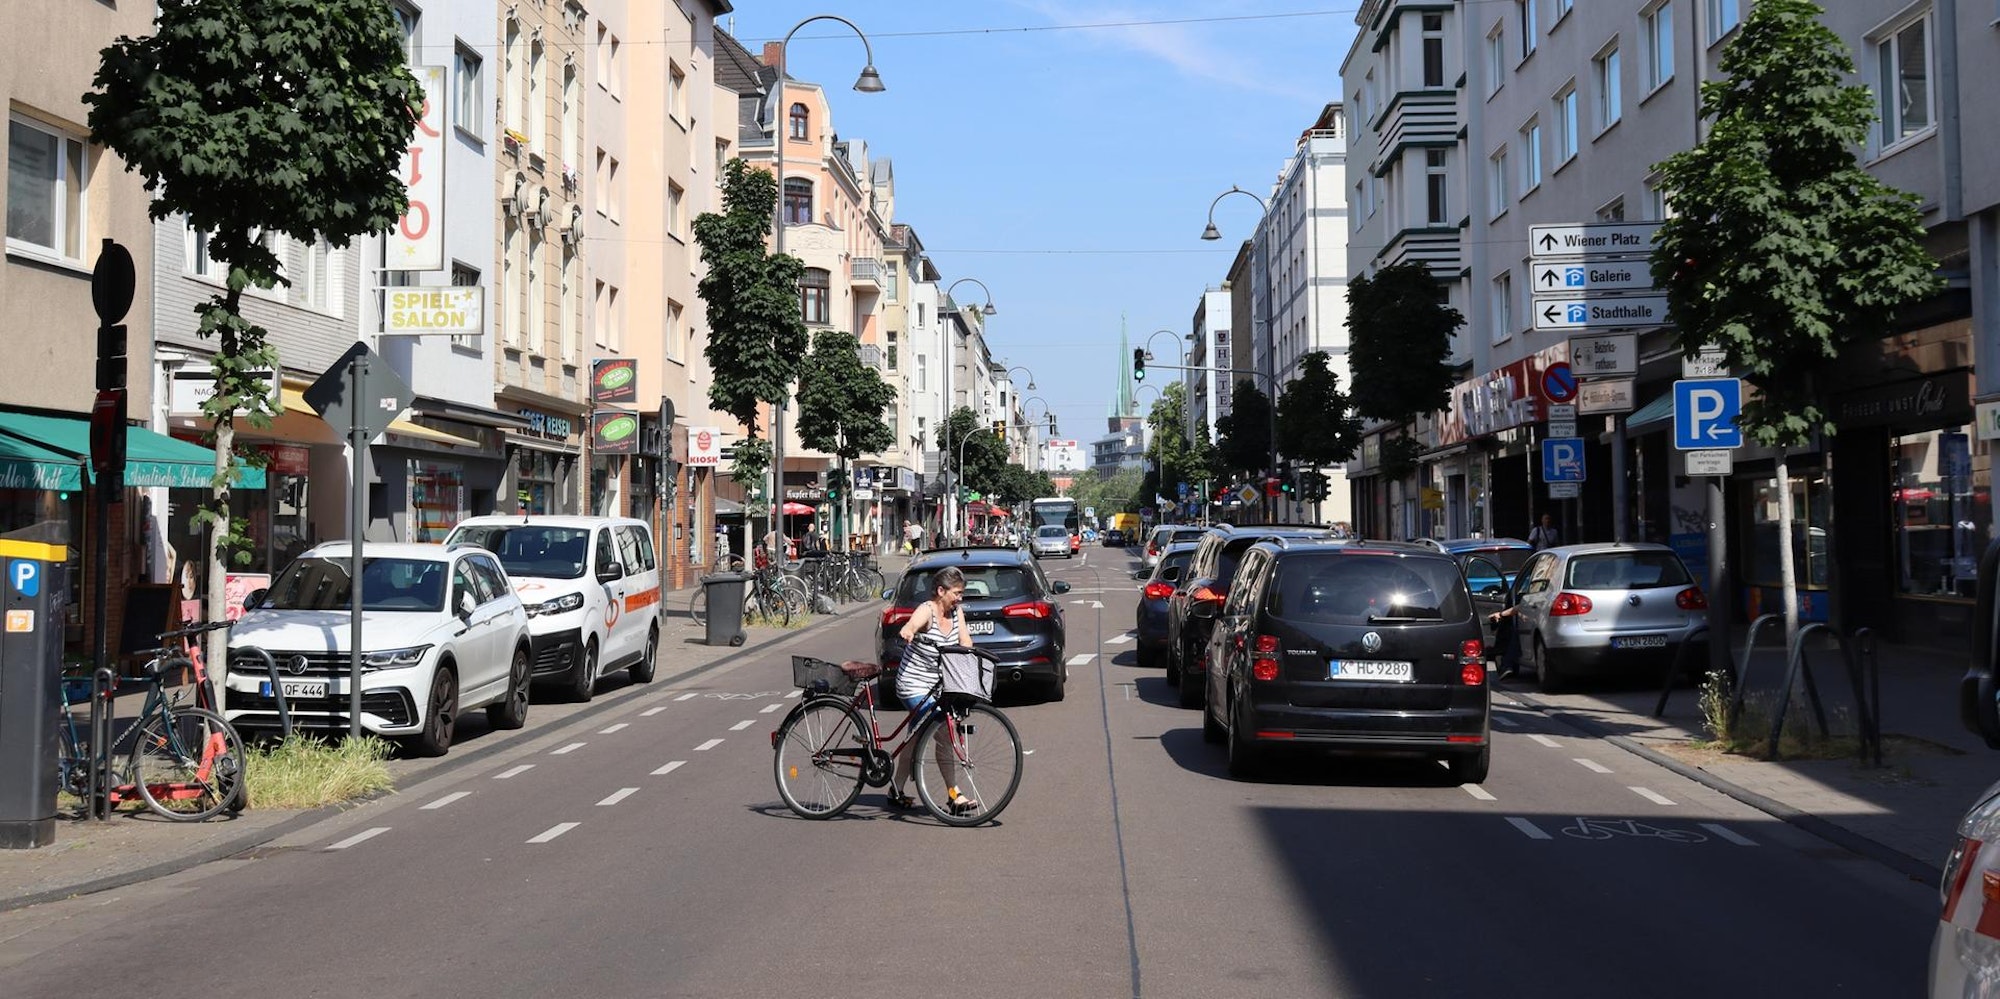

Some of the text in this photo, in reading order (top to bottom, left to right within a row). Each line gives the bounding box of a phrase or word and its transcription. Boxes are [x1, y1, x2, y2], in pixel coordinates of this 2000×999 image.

[1565, 233, 1640, 247] Wiener Platz
[1590, 269, 1631, 283] Galerie
[392, 292, 460, 310] SPIEL-
[391, 311, 466, 328] SALON
[1592, 306, 1652, 319] Stadthalle
[1595, 358, 1617, 370] rathaus
[546, 415, 571, 437] REISEN
[690, 455, 719, 464] KIOSK
[1340, 661, 1409, 676] K HC 9289
[285, 684, 322, 696] QF 444
